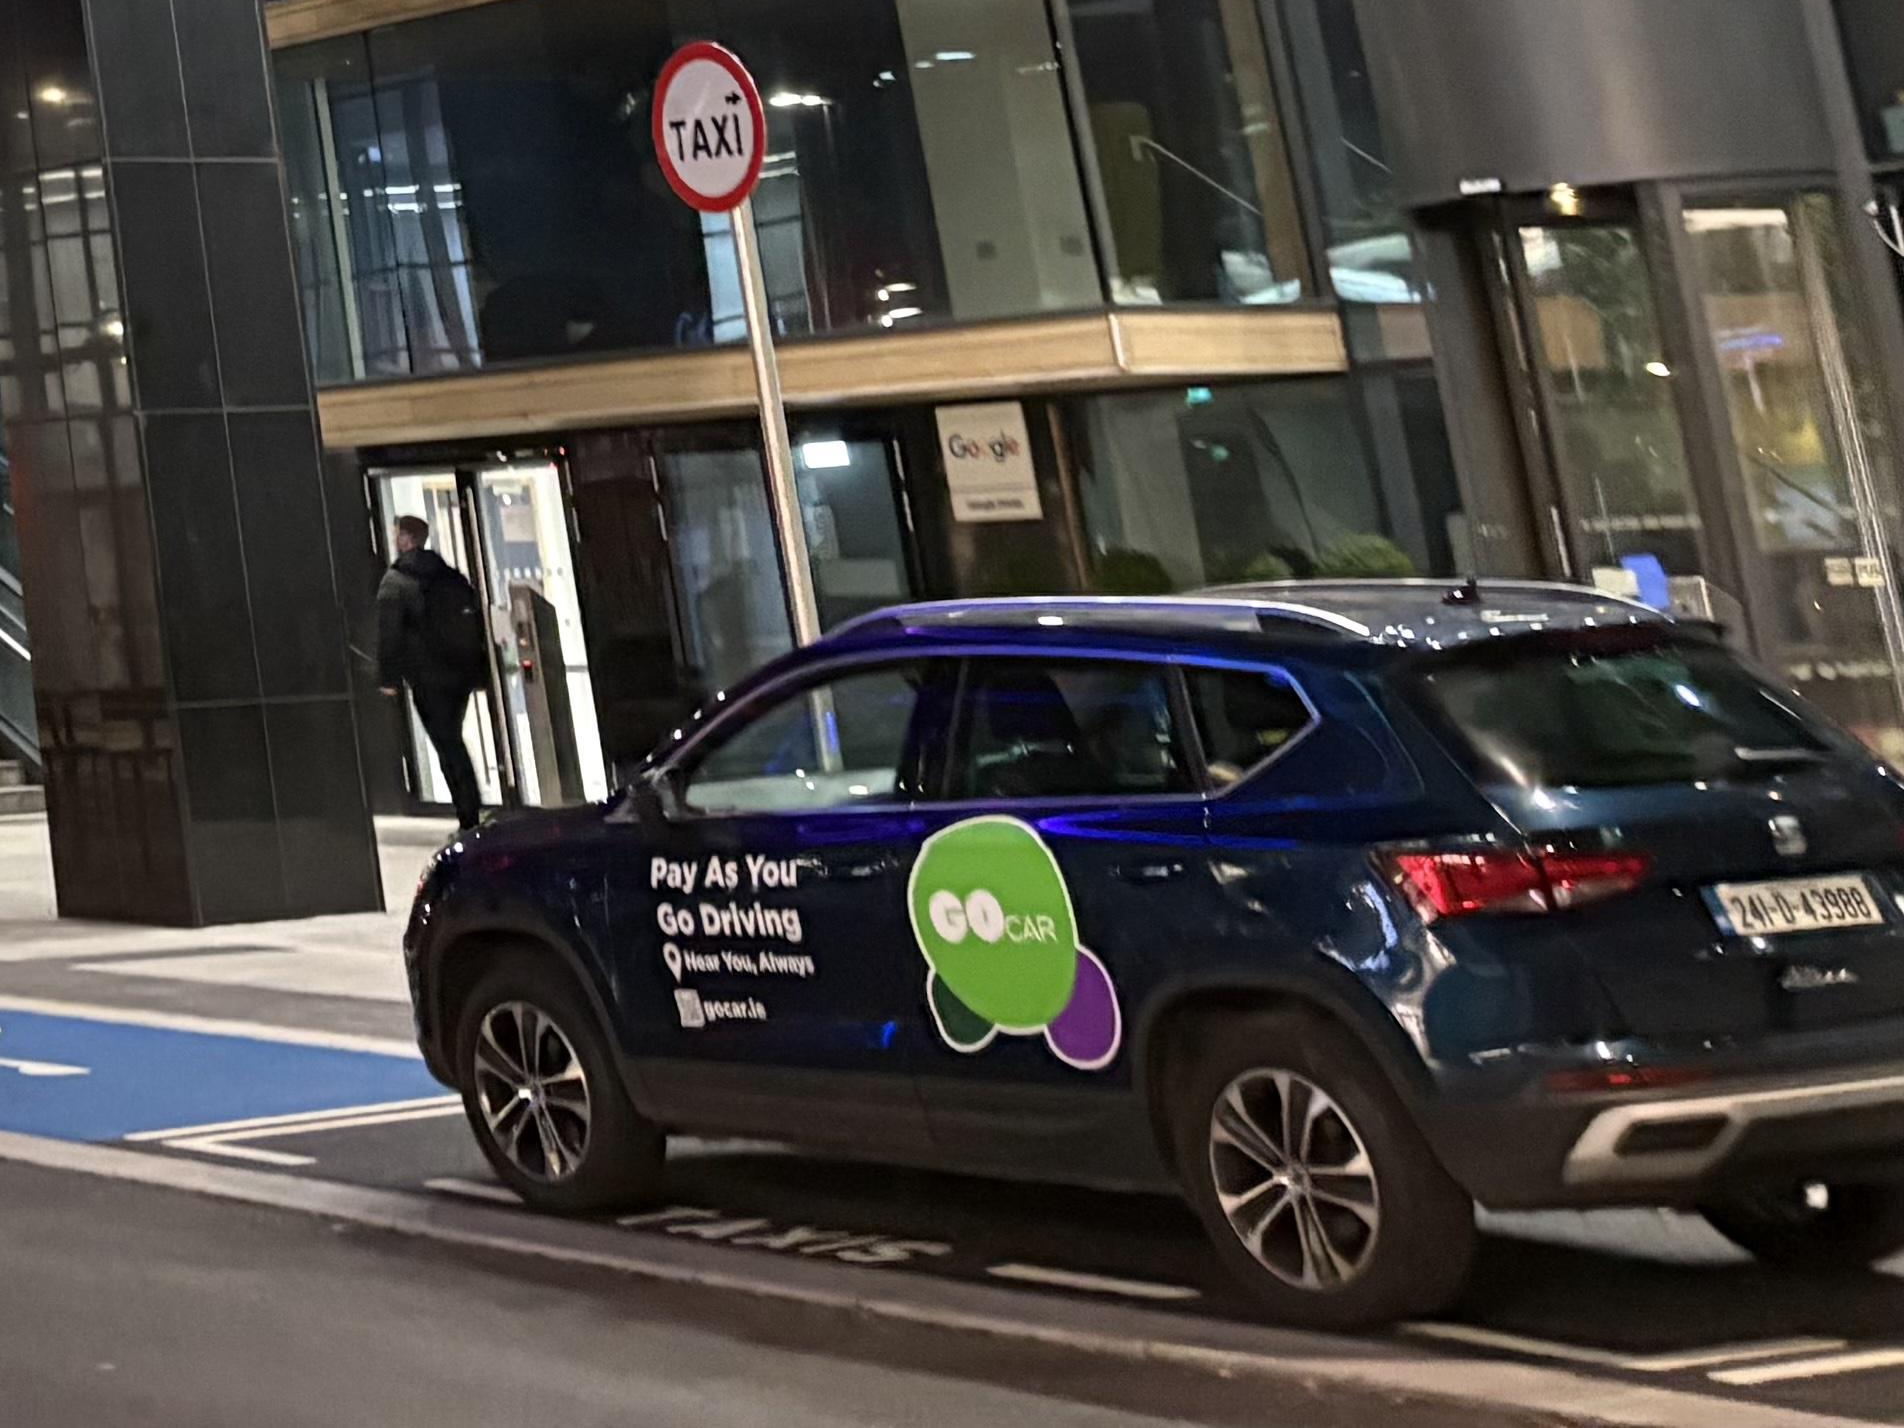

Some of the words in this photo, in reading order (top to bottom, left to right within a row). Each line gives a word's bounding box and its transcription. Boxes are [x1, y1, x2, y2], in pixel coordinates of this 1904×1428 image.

[669, 113, 744, 162] TAXI
[650, 856, 698, 895] Pay
[704, 855, 739, 889] As
[745, 853, 797, 888] You
[656, 901, 695, 936] Go
[698, 900, 802, 943] Driving
[1730, 886, 1872, 930] 241-D-43988
[682, 949, 721, 972] Near
[758, 950, 815, 978] Always
[702, 997, 768, 1022] gocar.ie
